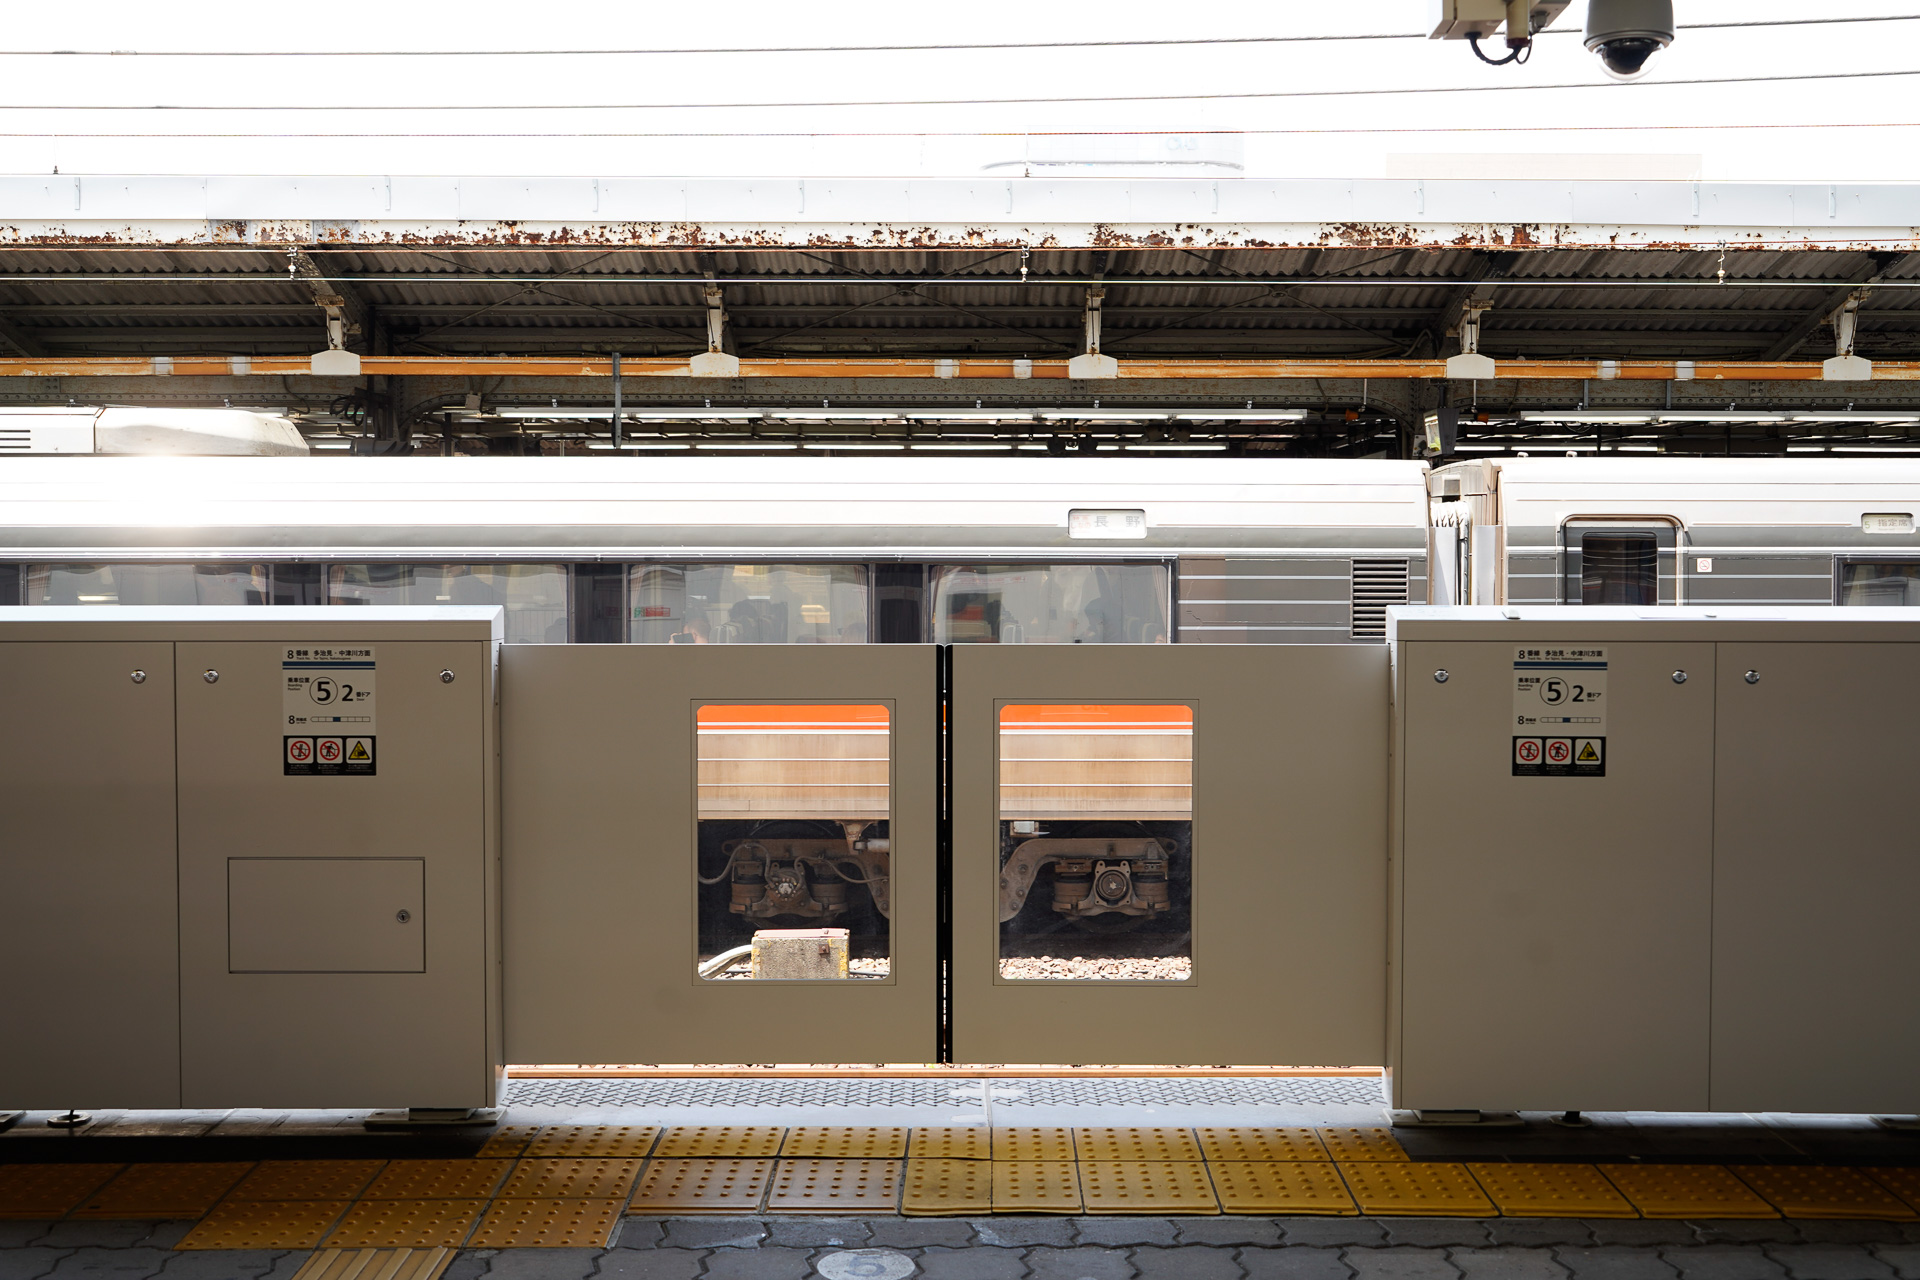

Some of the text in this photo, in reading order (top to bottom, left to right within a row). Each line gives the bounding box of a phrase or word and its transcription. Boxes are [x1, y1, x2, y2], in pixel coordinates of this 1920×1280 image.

[1878, 518, 1908, 527] 指定席
[288, 650, 294, 659] 8
[1518, 650, 1525, 659] 8
[317, 681, 331, 701] 5
[342, 685, 353, 702] 2
[1547, 682, 1561, 702] 5
[1572, 685, 1584, 702] 2
[288, 715, 295, 724] 8
[1518, 716, 1524, 724] 8
[847, 1255, 887, 1277] 5
